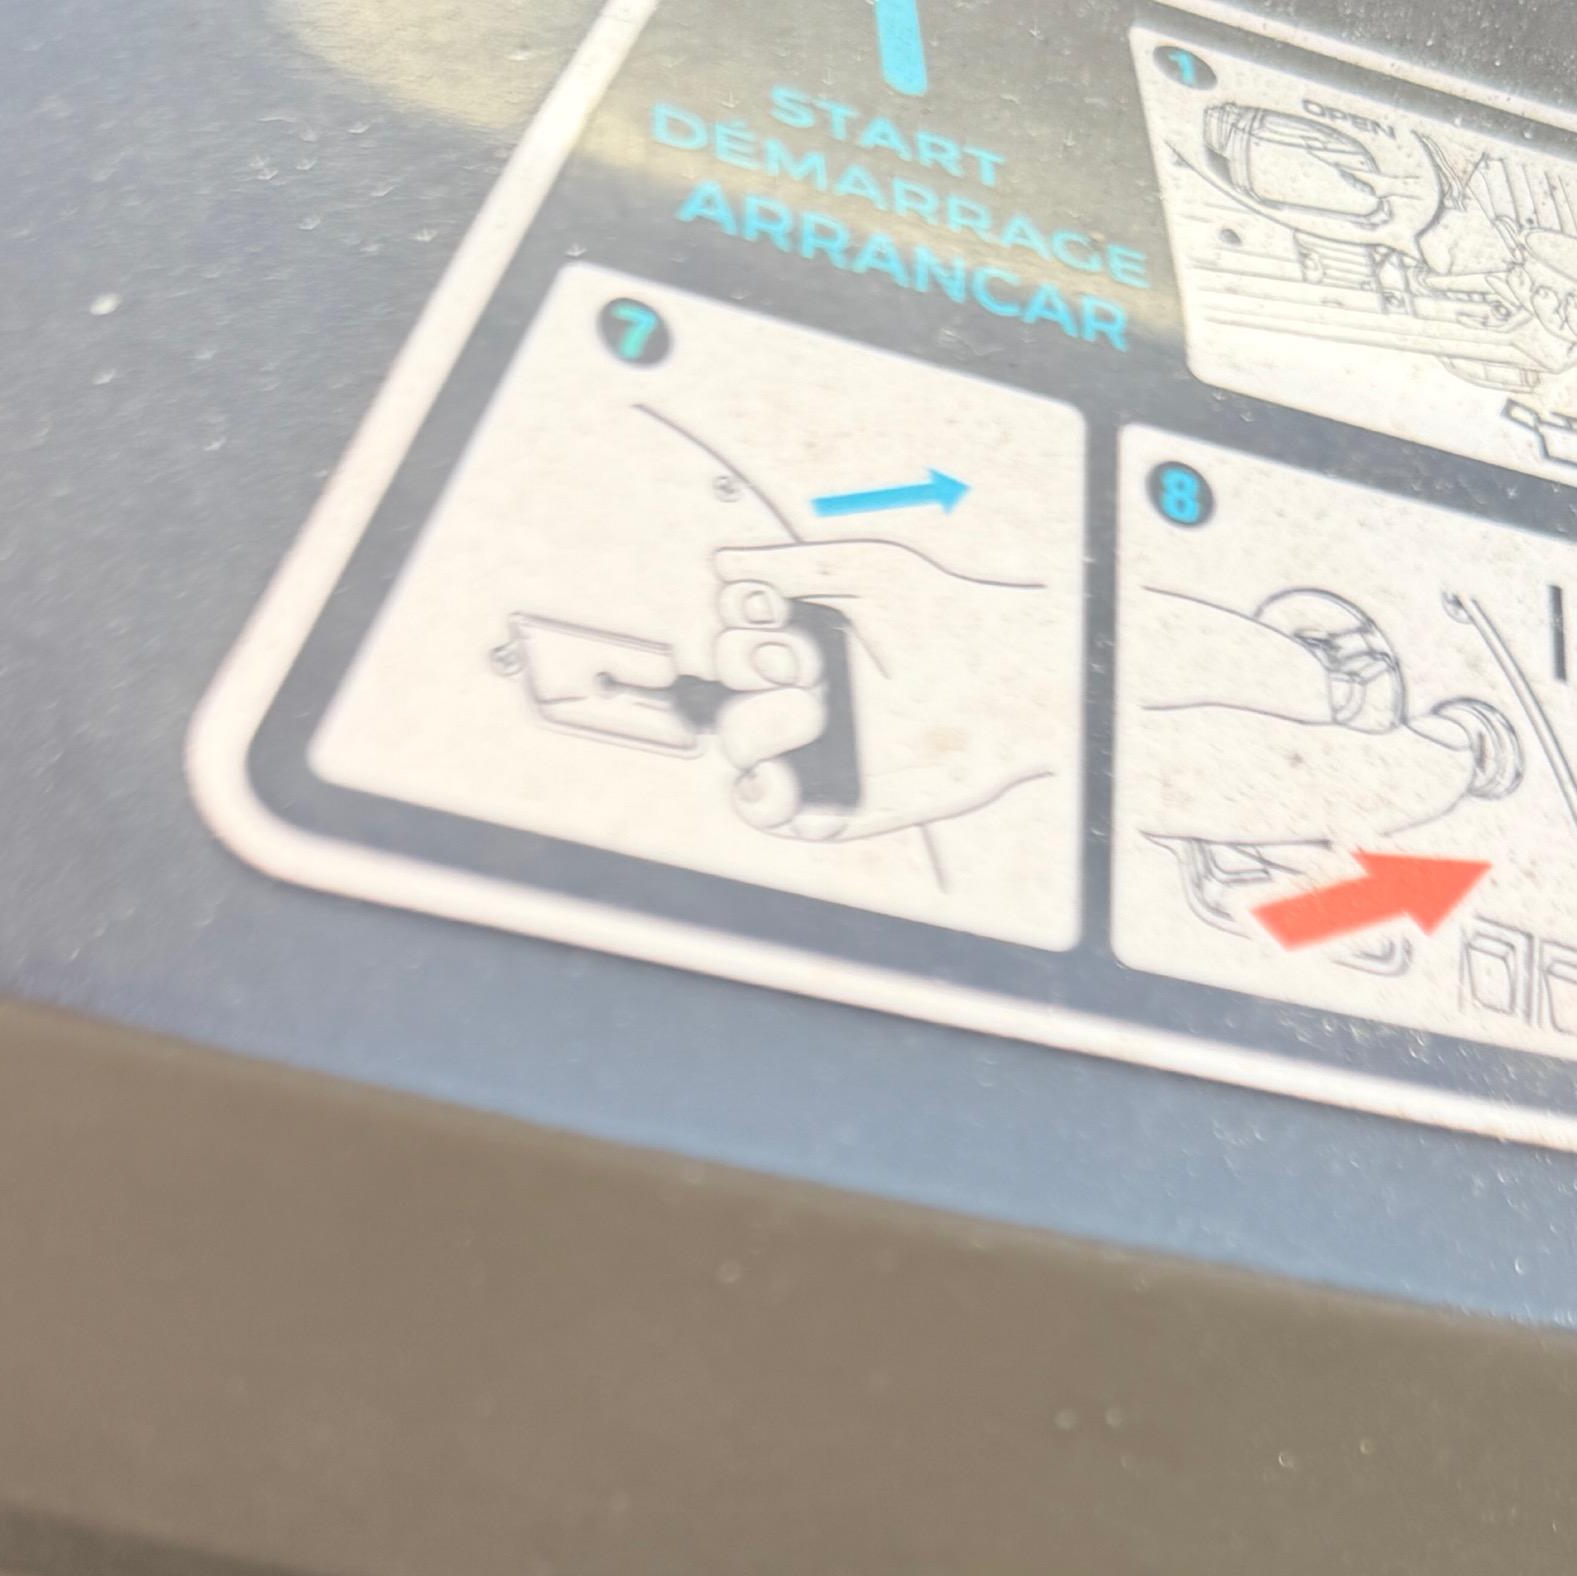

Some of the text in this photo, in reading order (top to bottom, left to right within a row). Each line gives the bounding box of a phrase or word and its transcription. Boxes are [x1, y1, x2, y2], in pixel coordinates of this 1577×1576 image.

[1168, 50, 1199, 87] 1
[771, 86, 1005, 187] START
[1301, 97, 1398, 140] OPEN
[651, 102, 1150, 289] DÉMARRAGE
[675, 181, 1130, 353] ARRANCAR
[610, 305, 658, 360] 7
[1159, 467, 1199, 518] 8
